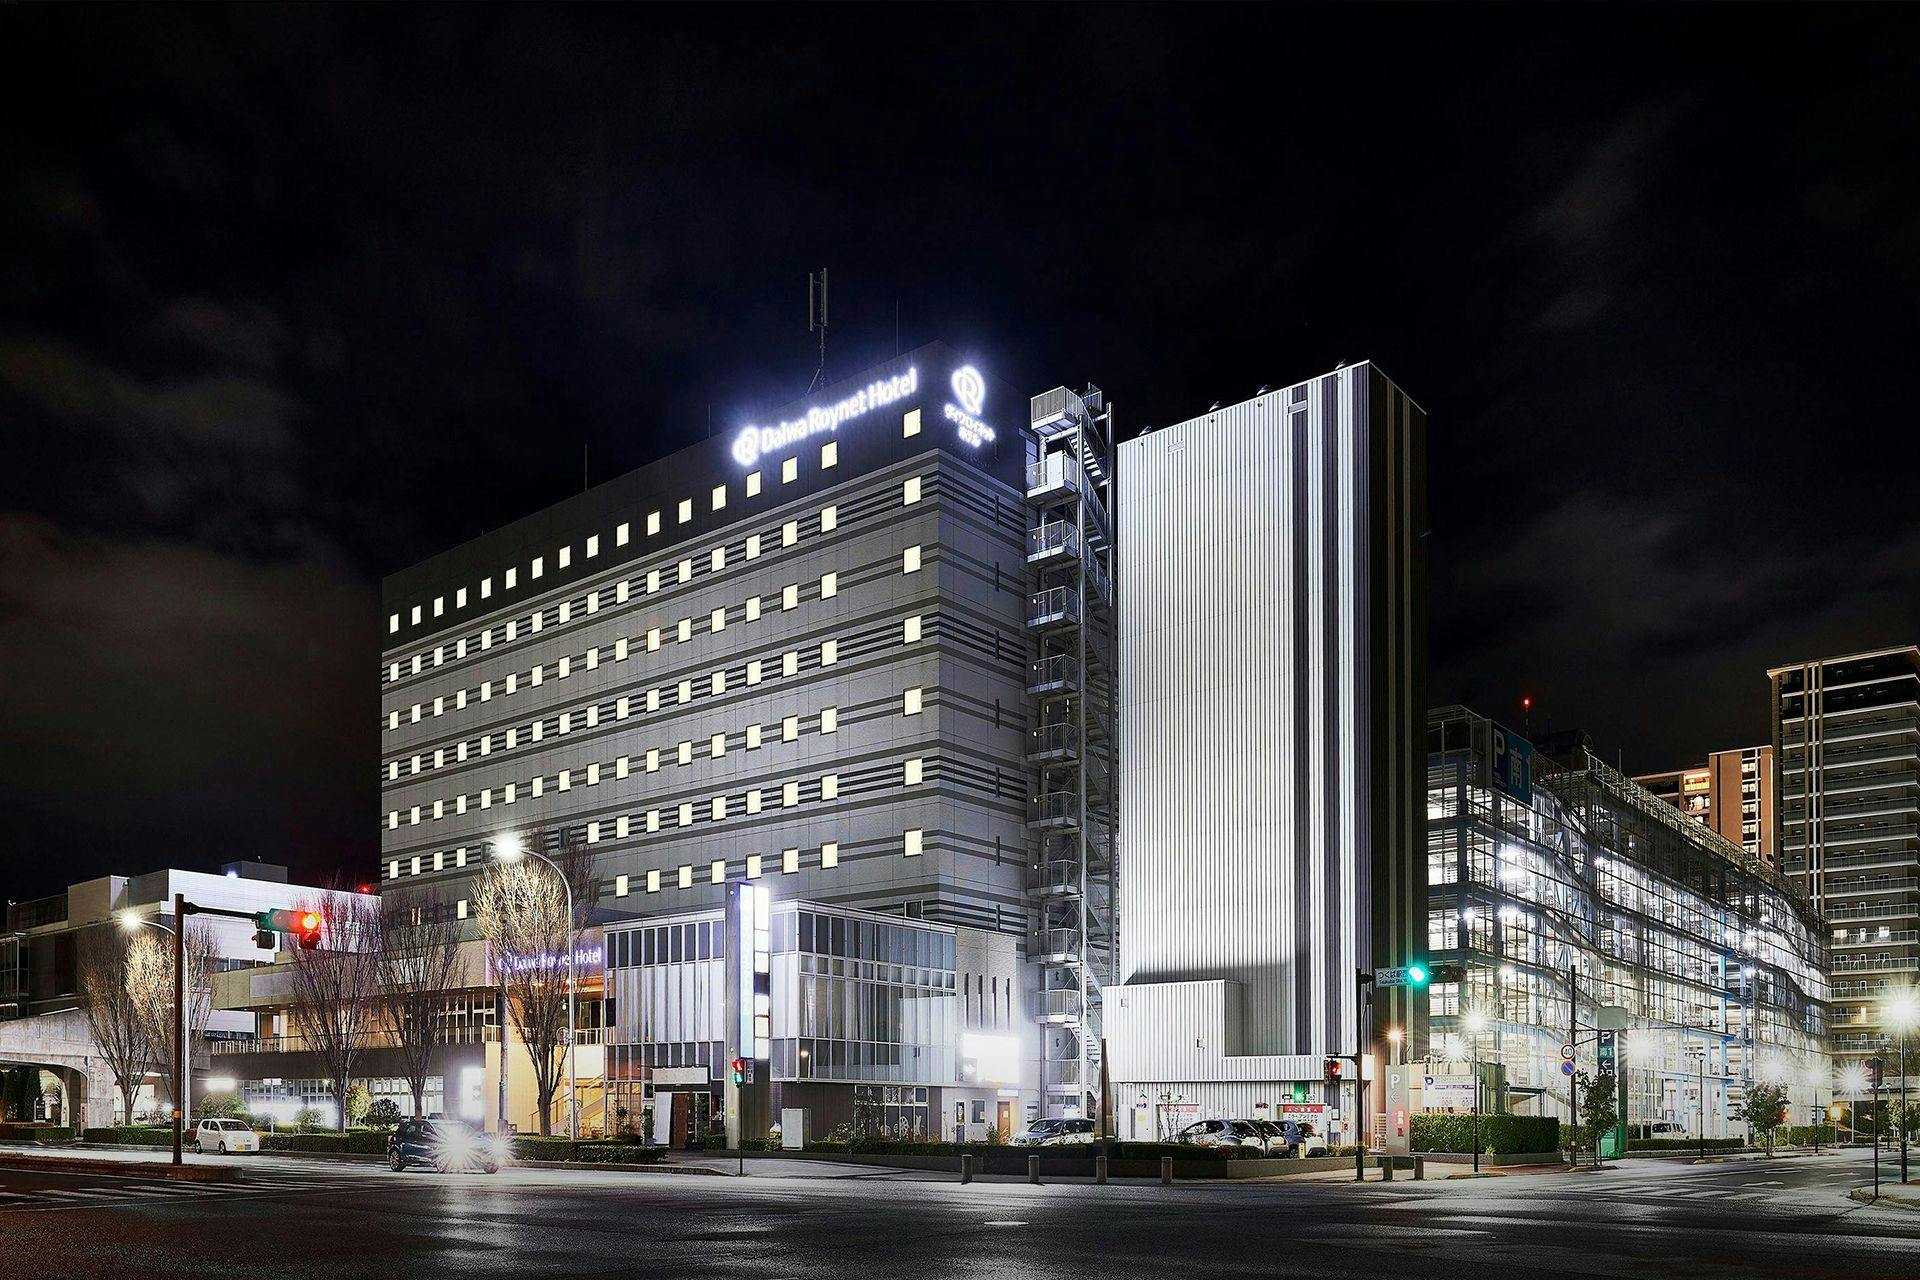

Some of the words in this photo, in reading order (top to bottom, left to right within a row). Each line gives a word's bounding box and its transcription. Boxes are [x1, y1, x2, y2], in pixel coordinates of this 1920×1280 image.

[761, 419, 807, 453] Daiwa
[808, 389, 867, 432] Roynet
[867, 367, 917, 411] Hotel
[1494, 729, 1505, 768] P
[576, 946, 602, 964] Hotel
[1601, 1031, 1611, 1043] P
[1390, 1073, 1400, 1089] P
